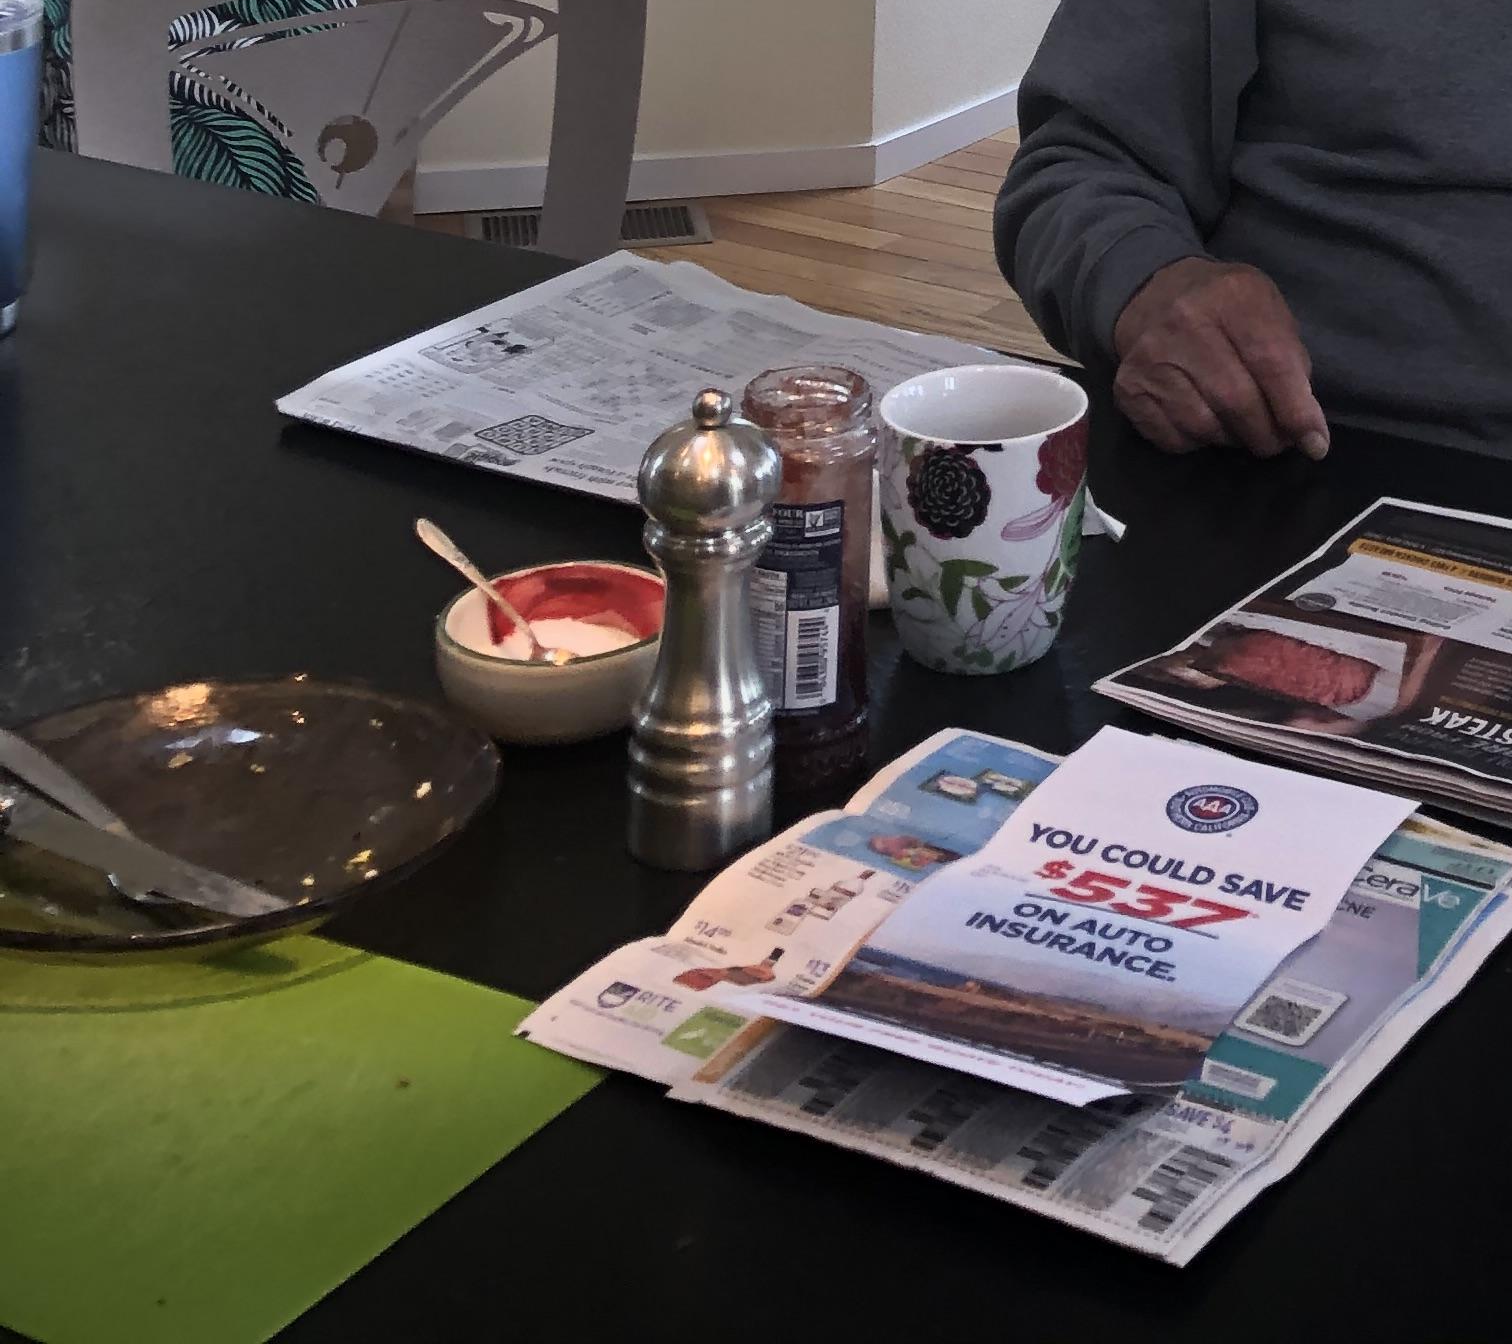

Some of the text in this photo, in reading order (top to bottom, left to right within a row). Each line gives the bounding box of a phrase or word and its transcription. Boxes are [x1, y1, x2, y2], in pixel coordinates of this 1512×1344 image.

[1029, 823, 1311, 912] YOU COULD SAVE
[965, 911, 1177, 982] INSURANCE.
[1013, 903, 1173, 953] ON AUTO
[637, 991, 682, 1013] RITE
